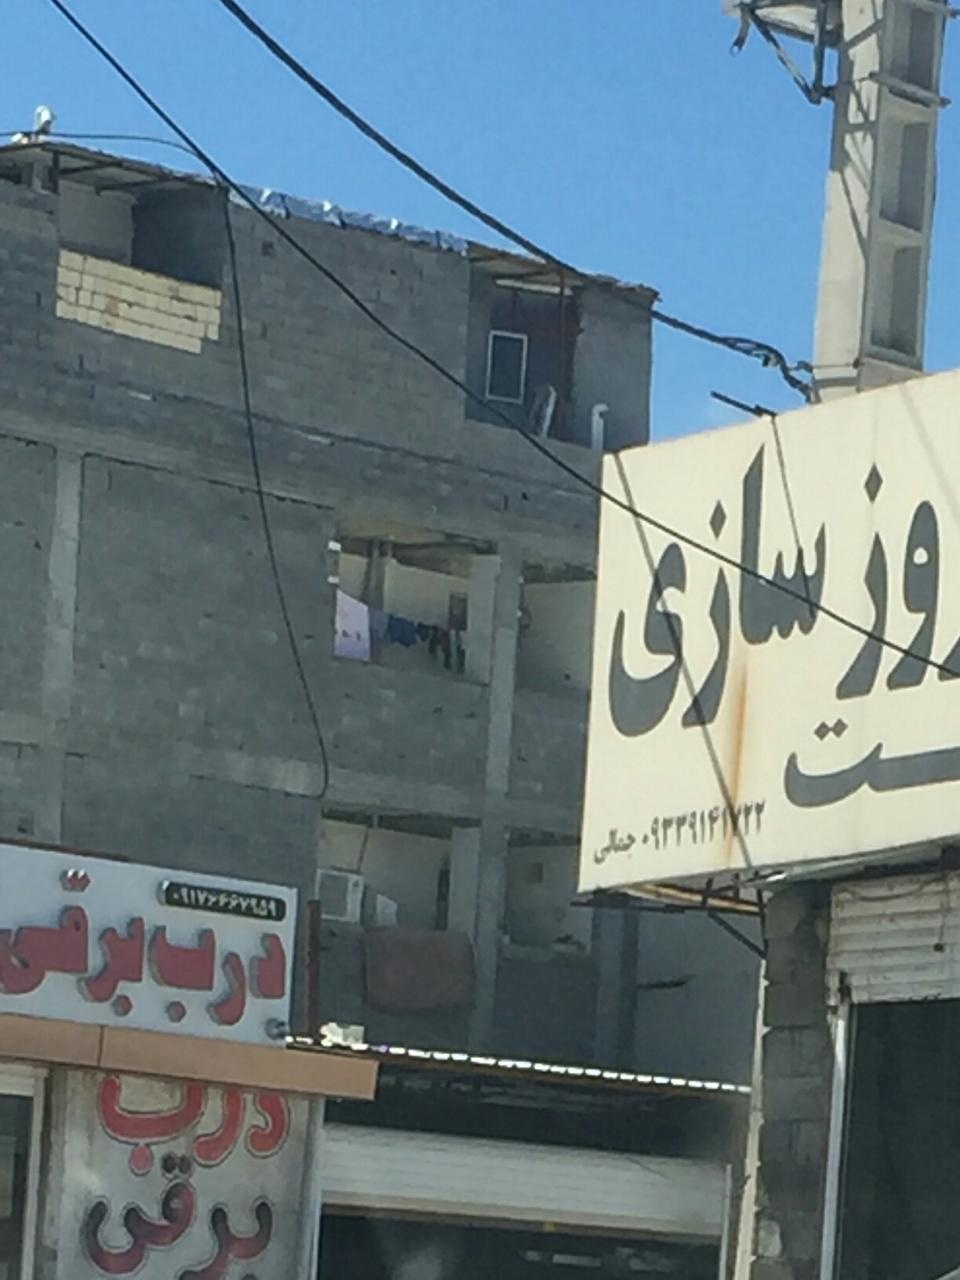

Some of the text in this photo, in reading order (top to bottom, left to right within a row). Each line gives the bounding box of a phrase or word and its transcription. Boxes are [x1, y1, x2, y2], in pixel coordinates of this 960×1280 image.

[609, 443, 826, 737] سازی
[149, 924, 286, 1026] درب
[100, 1076, 289, 1177] درب
